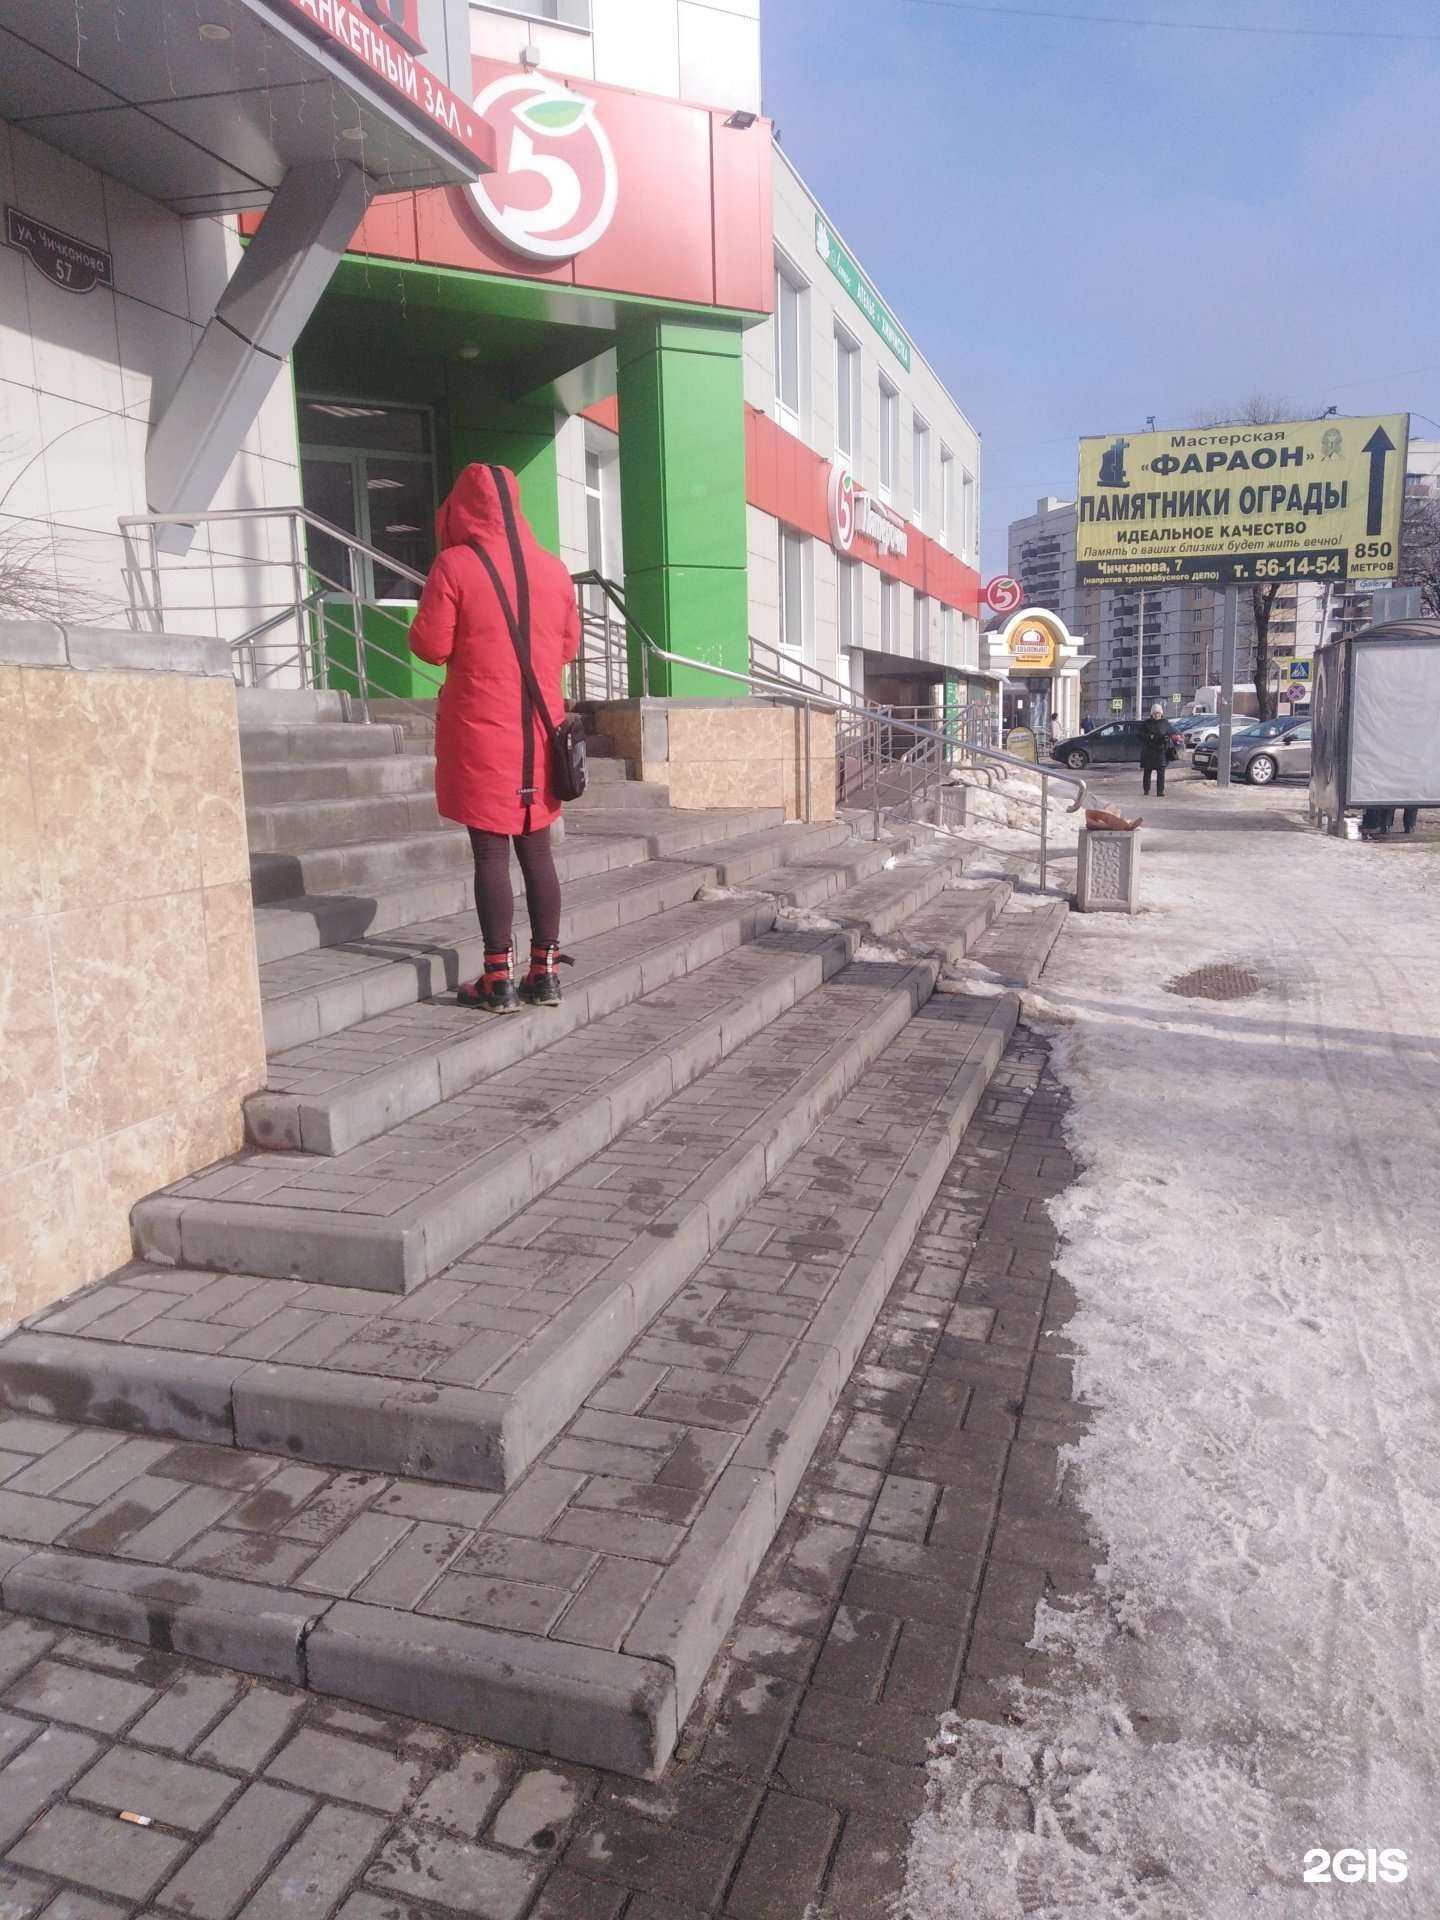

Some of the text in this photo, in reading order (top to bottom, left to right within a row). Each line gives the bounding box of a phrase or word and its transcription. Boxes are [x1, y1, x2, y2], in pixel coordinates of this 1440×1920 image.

[423, 77, 462, 137] ЗАЛ
[502, 125, 582, 233] 5
[17, 223, 105, 273] ул. Чичканова
[56, 258, 73, 282] 57
[1171, 431, 1285, 448] Мастерская
[1141, 446, 1315, 476] «ФАРАОН»
[1080, 480, 1348, 523] ПАМЯТНИКИ ОГРАДЫ
[1116, 521, 1307, 544] ИДЕАЛЬНОЕ КАЧЕСТВО
[1083, 535, 1343, 558] Память о ваших близких будет жить вечно!
[1355, 542, 1392, 558] 850
[1097, 559, 1183, 575] Чичканова, 7
[1255, 556, 1341, 577] 56-14-54
[1350, 563, 1394, 573] МЕТРОВ
[1083, 576, 1123, 585] (напротив
[1125, 573, 1190, 584] троллейбусного
